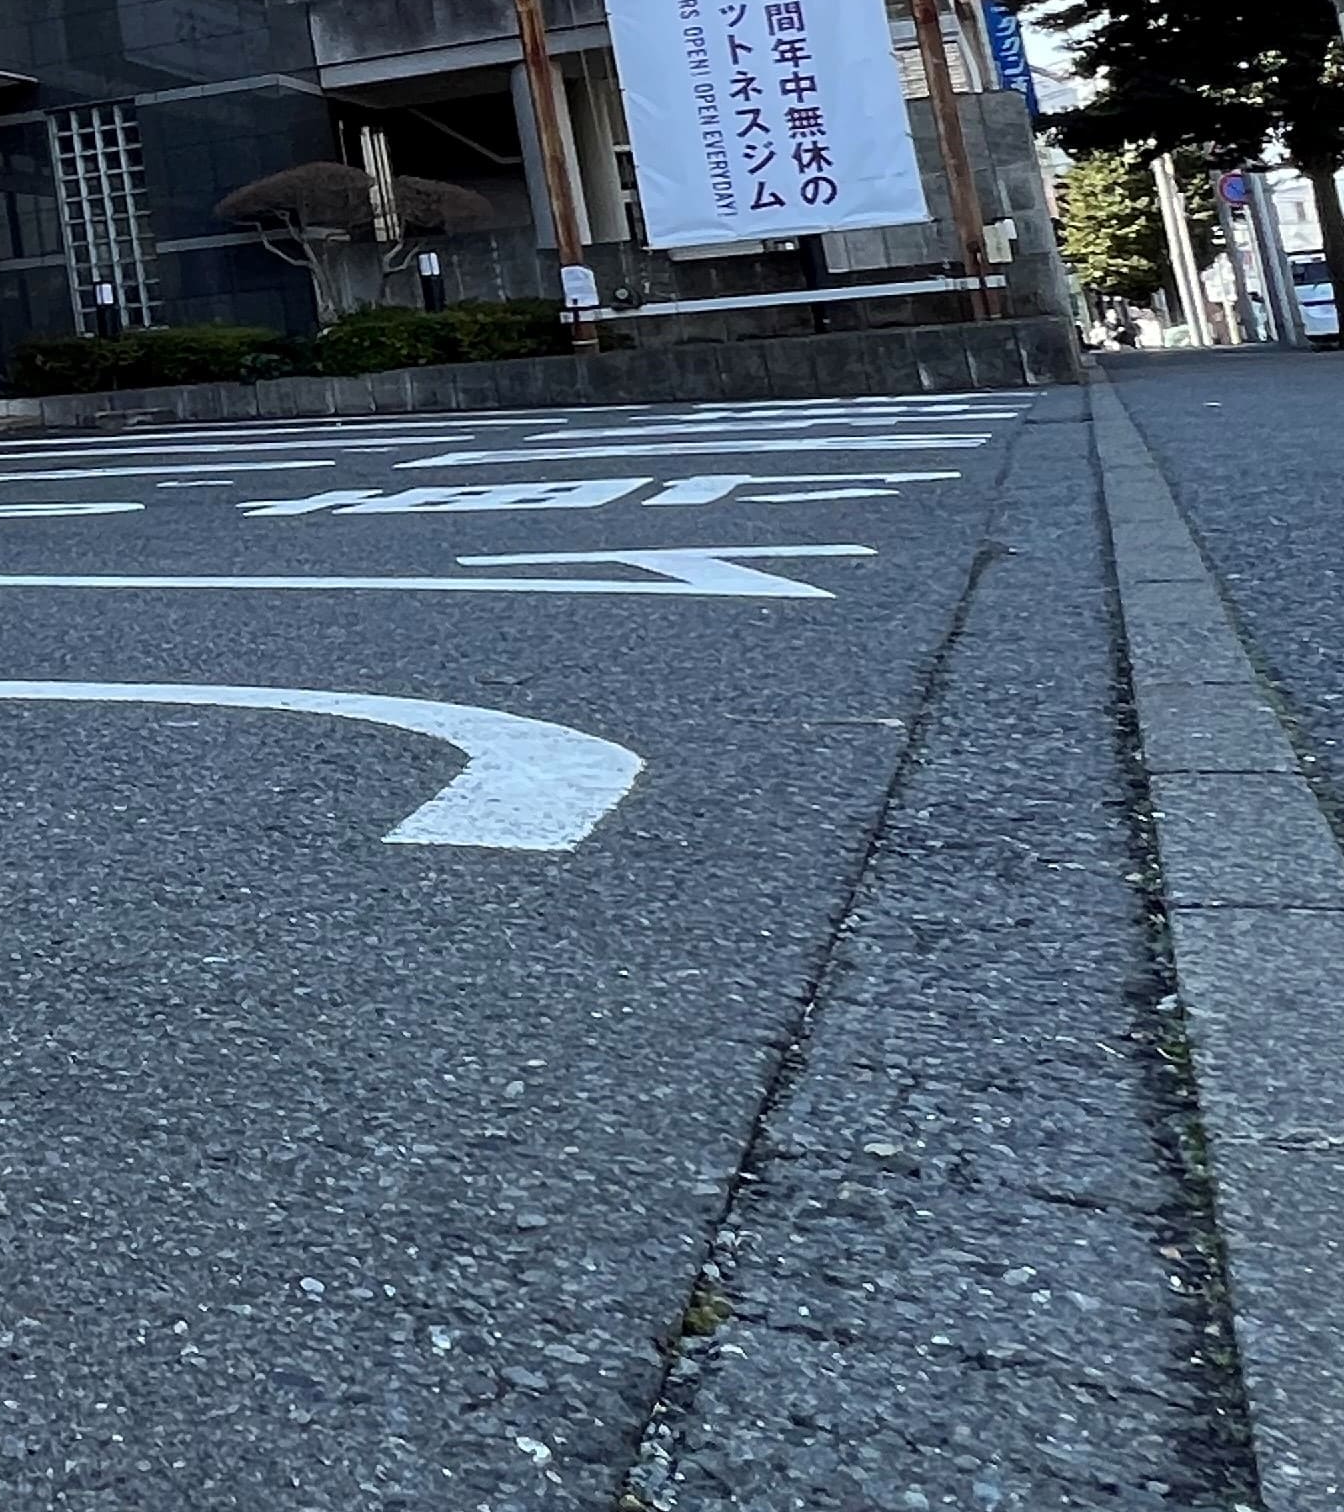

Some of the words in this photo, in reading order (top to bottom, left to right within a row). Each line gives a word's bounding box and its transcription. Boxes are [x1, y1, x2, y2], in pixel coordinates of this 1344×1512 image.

[683, 26, 713, 78] OPEN!
[692, 82, 721, 126] OPEN
[702, 129, 739, 218] EVERYDAY!
